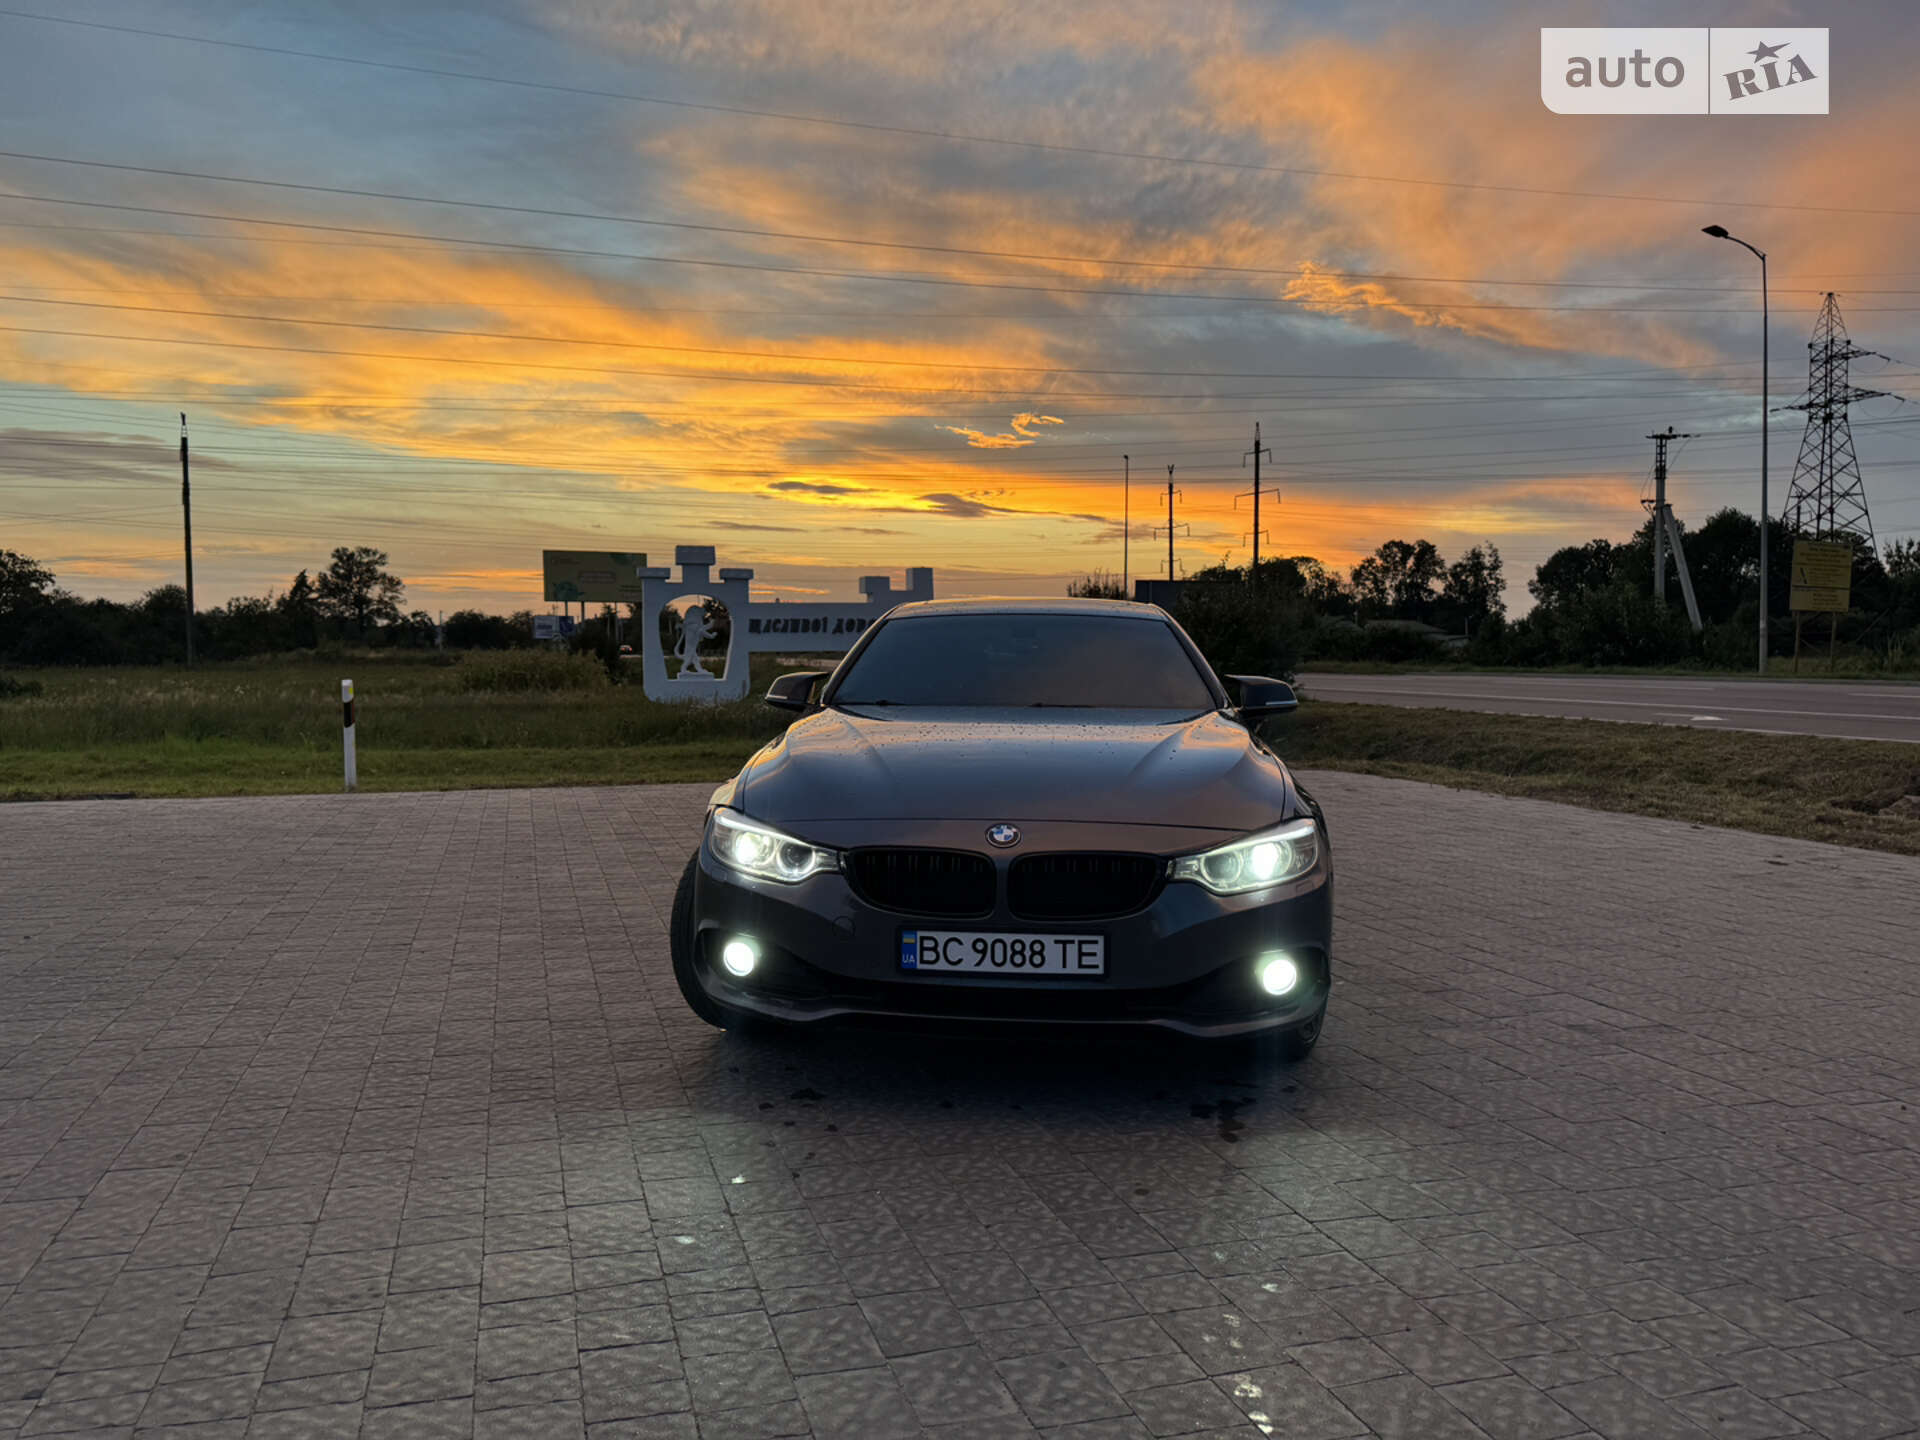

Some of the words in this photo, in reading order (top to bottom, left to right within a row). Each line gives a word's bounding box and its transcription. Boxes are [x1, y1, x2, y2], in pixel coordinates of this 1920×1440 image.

[902, 954, 916, 964] UA
[918, 936, 963, 966] BC
[971, 938, 1046, 968] 9088
[1054, 940, 1099, 969] TE
